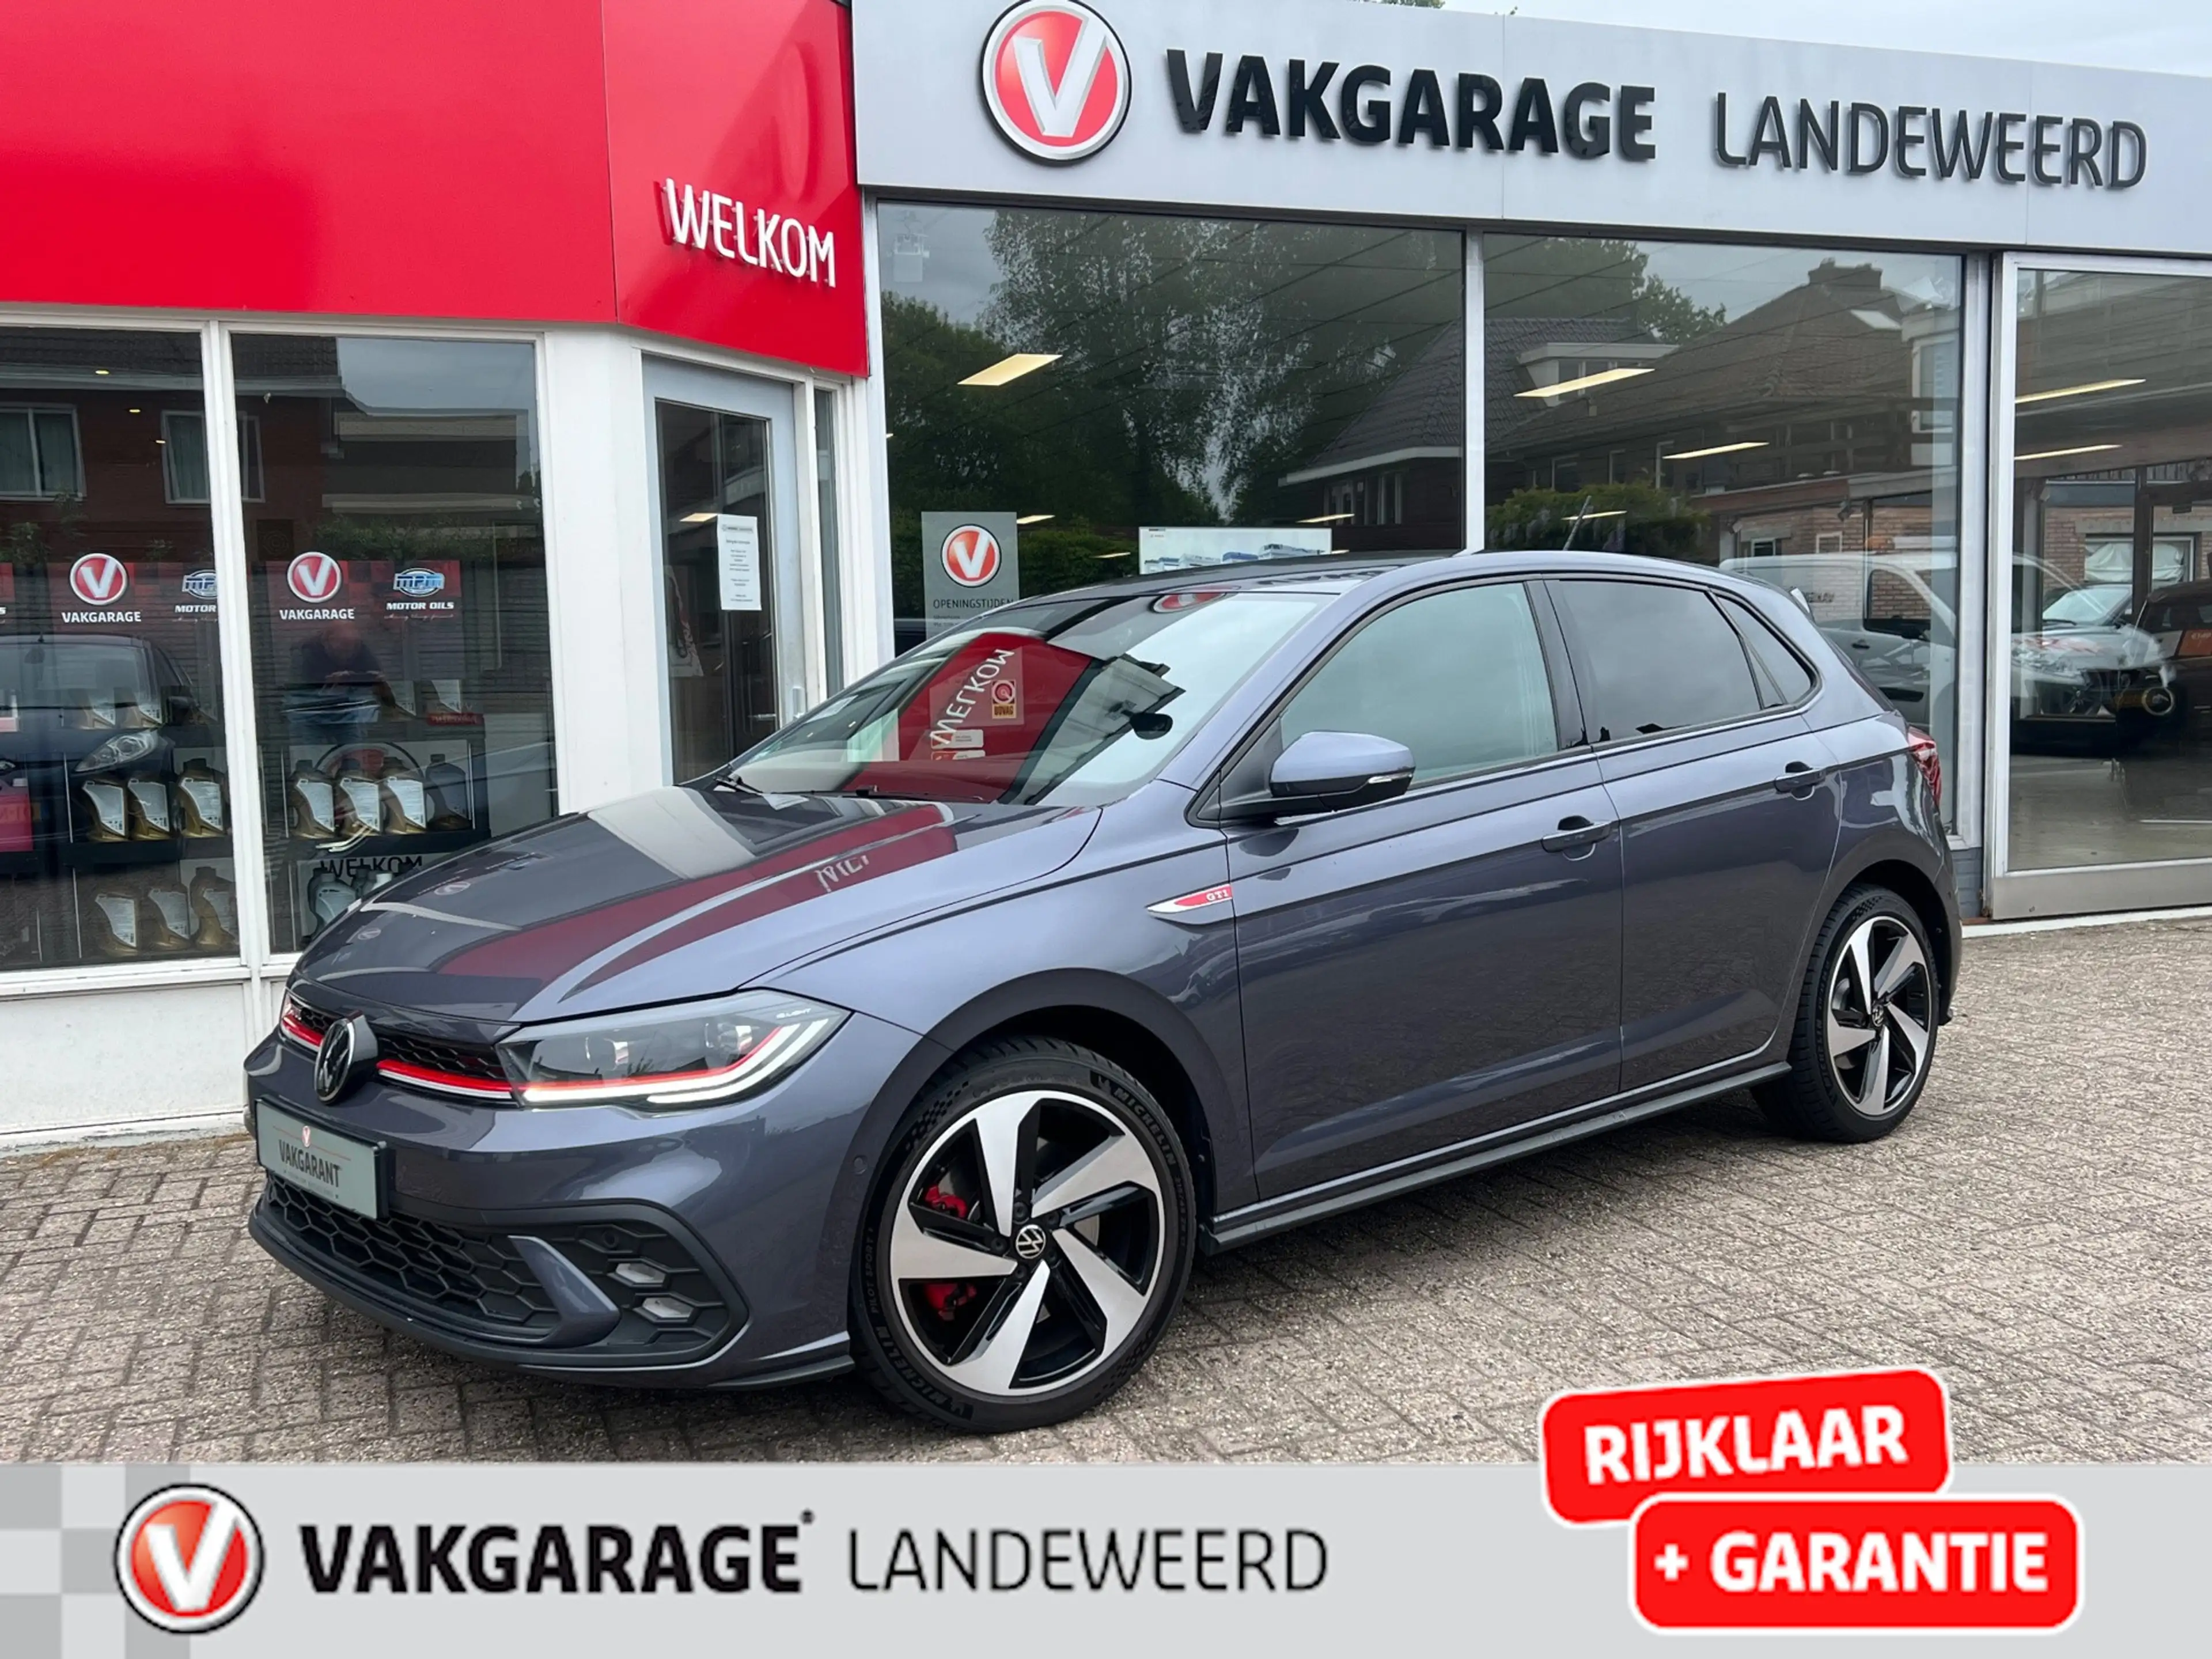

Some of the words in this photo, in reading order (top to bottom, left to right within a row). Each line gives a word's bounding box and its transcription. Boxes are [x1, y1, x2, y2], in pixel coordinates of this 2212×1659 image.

[1166, 48, 1656, 160] VAKGARAGE
[1717, 92, 2147, 190] LANDEWEERD
[665, 177, 836, 288] WELKOM
[61, 611, 142, 623] VAKGARAGE
[175, 605, 217, 613] MOTOR
[279, 608, 355, 620] VAKGARAGE
[386, 602, 426, 610] MOTOR
[429, 601, 454, 609] OILS
[1206, 889, 1229, 902] GTI
[1112, 1087, 1177, 1166] MICHELIN
[278, 1138, 343, 1188] VAKGARANT
[865, 1236, 874, 1277] SPORT
[867, 1281, 878, 1314] PILOT
[876, 1325, 949, 1407] MICHELIN
